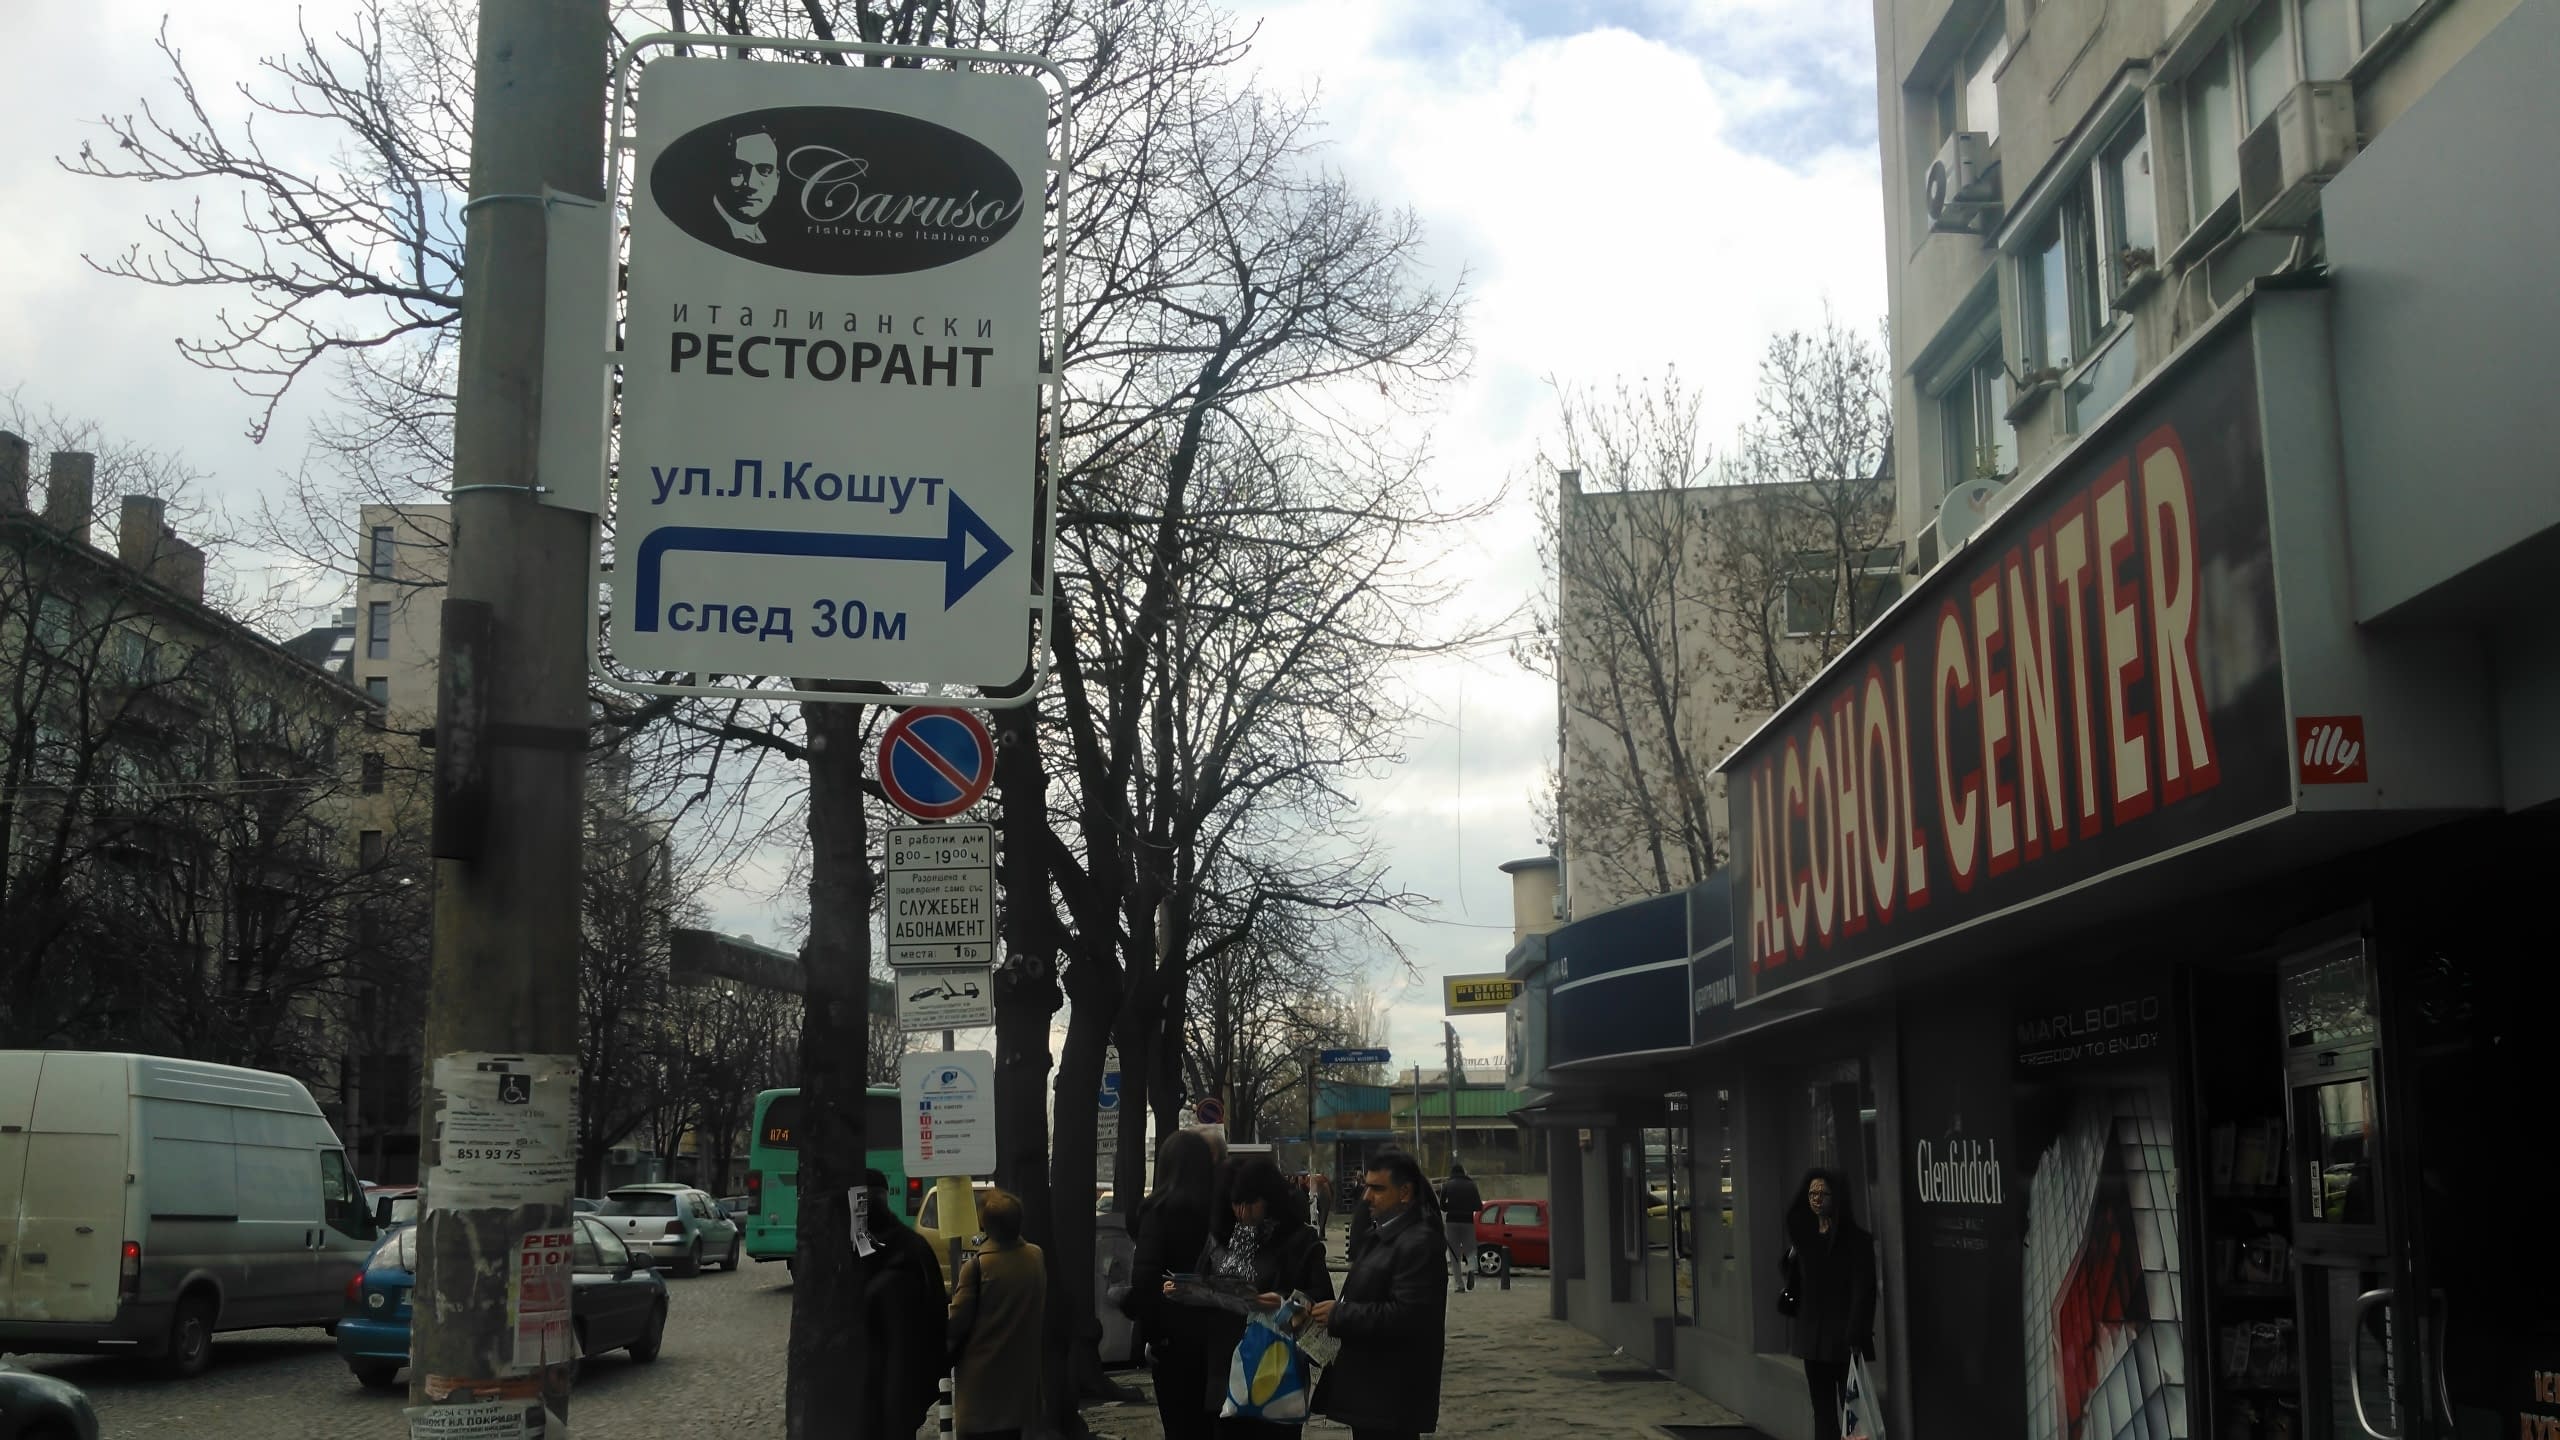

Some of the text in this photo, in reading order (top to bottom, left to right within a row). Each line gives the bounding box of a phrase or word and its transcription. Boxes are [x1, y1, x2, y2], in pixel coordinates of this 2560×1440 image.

[787, 144, 1025, 231] Caruso
[806, 226, 991, 244] ristorante italiano
[672, 303, 993, 338] италиански
[670, 331, 994, 388] РЕСТОРАНТ
[667, 598, 907, 644] след 30м
[1749, 424, 2220, 974] ALCOHOL CENTER
[2303, 724, 2360, 775] illy
[895, 835, 985, 848] В работни дни
[899, 898, 980, 916] СЛУЖЕБЕН
[895, 919, 986, 939] АБОНАМЕНТ
[2016, 994, 2160, 1043] MARLBORO
[2084, 1041, 2106, 1057] TO
[2108, 1031, 2160, 1054] ENJOY
[457, 1148, 521, 1160] 851 93 75
[1916, 1138, 2003, 1205] Glenfiddich
